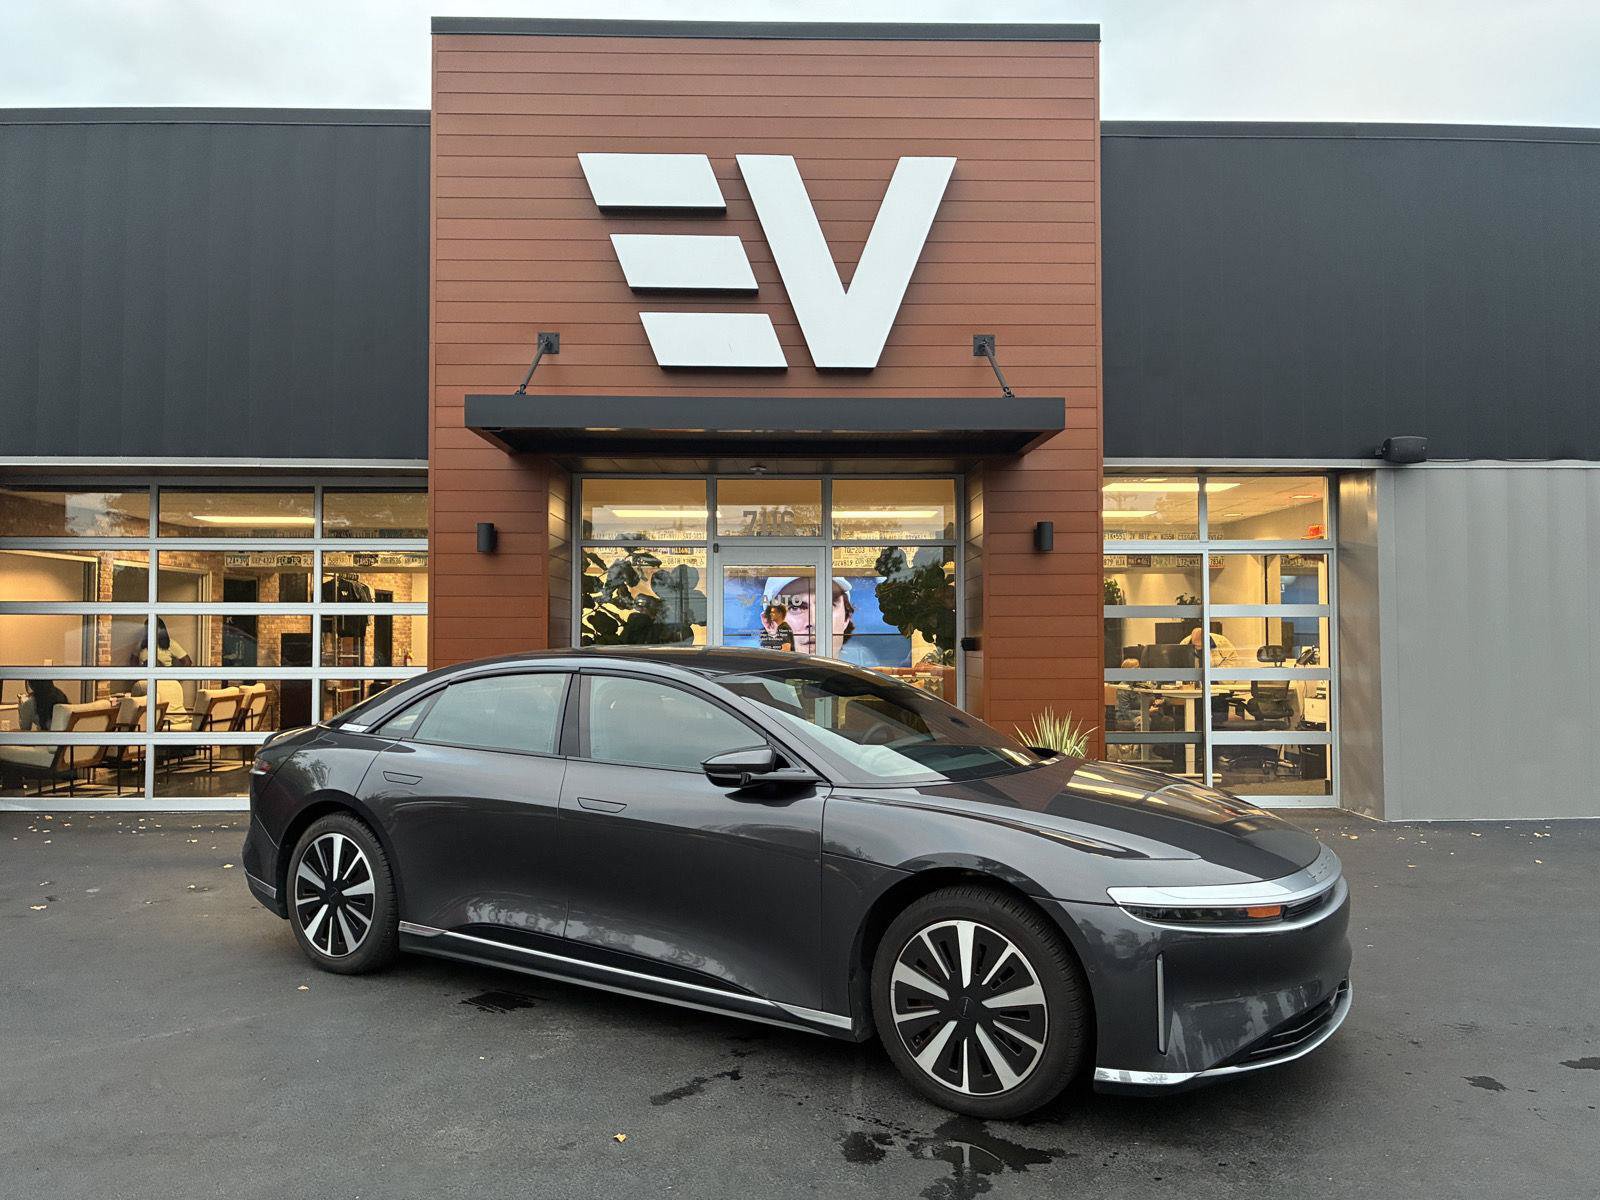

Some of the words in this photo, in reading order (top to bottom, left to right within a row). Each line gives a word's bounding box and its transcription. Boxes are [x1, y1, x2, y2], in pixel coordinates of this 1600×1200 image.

[577, 152, 957, 370] EV
[743, 510, 795, 535] 716
[762, 594, 803, 607] AUTO
